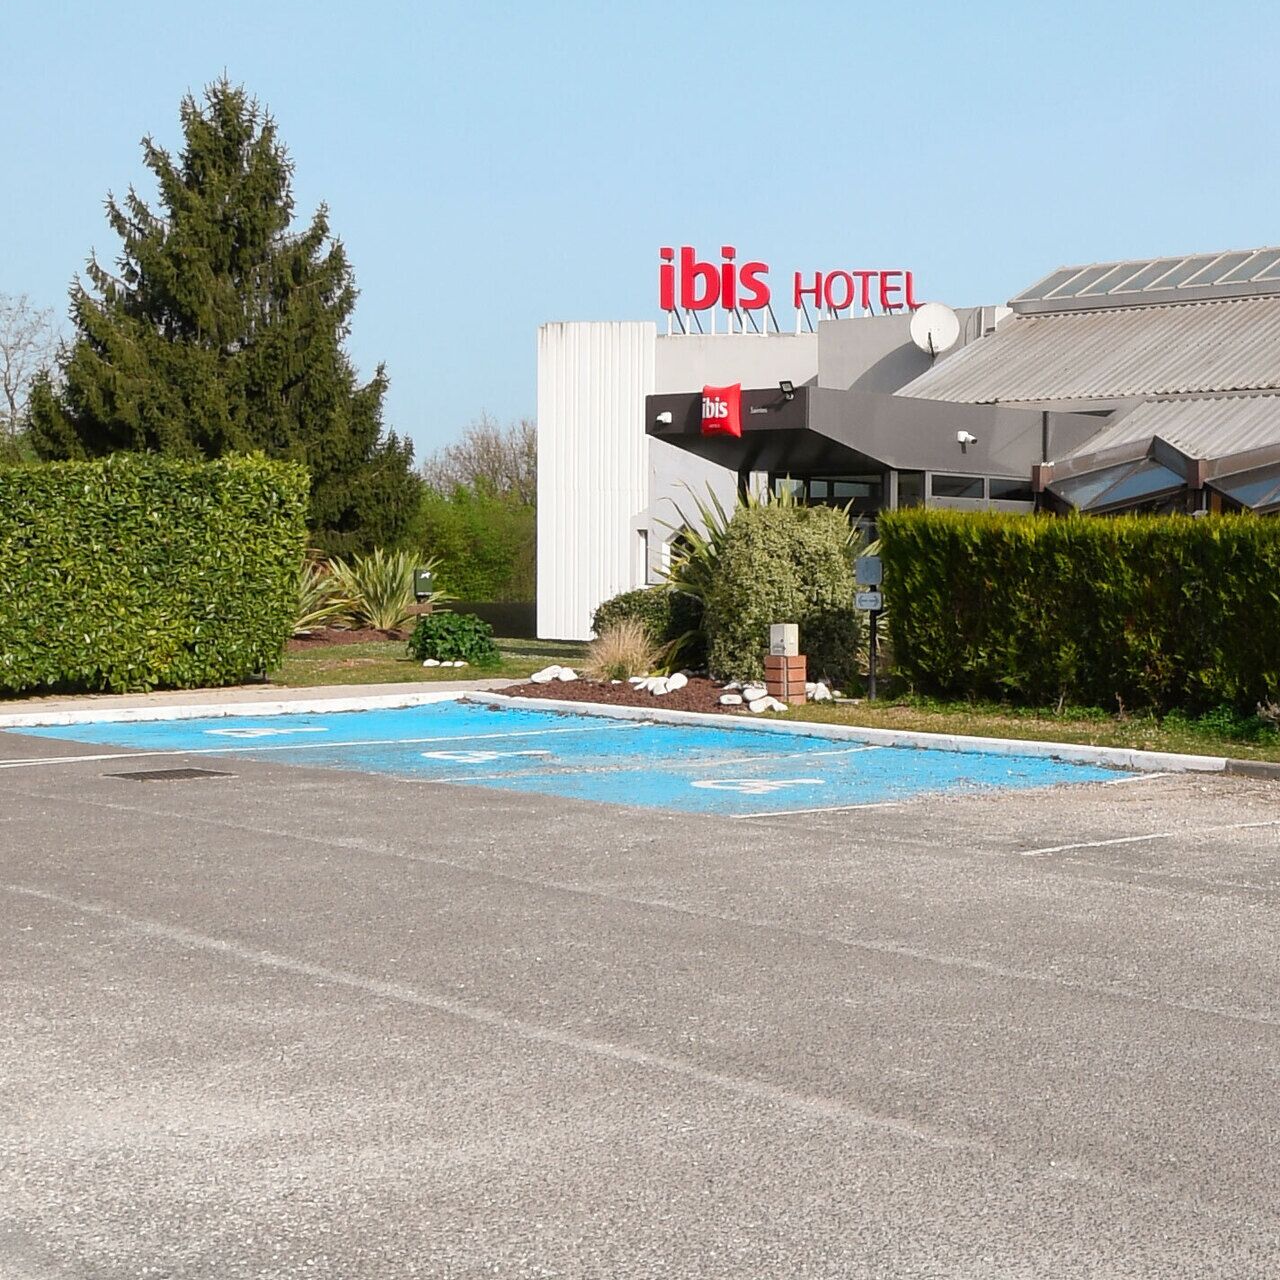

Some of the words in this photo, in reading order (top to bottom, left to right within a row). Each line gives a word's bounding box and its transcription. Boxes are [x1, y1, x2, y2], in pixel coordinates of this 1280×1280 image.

[659, 246, 770, 310] ibis
[794, 270, 927, 310] HOTEL
[702, 396, 728, 419] ibis
